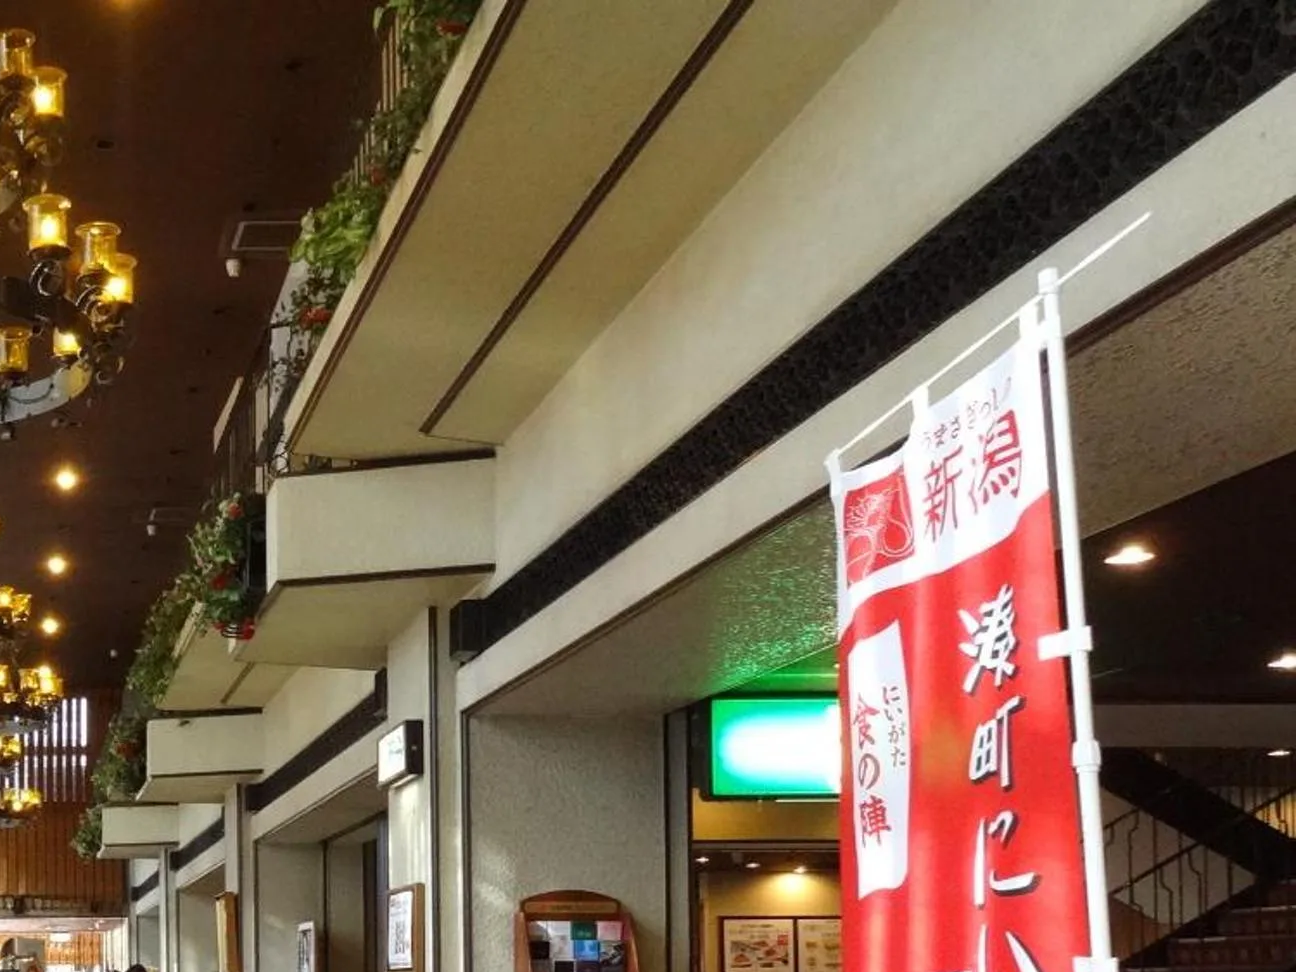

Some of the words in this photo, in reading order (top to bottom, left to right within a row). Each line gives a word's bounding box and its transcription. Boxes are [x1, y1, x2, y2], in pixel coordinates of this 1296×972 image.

[923, 409, 1023, 543] 新潟
[854, 692, 892, 848] 食の陣
[882, 686, 906, 768] にいがた
